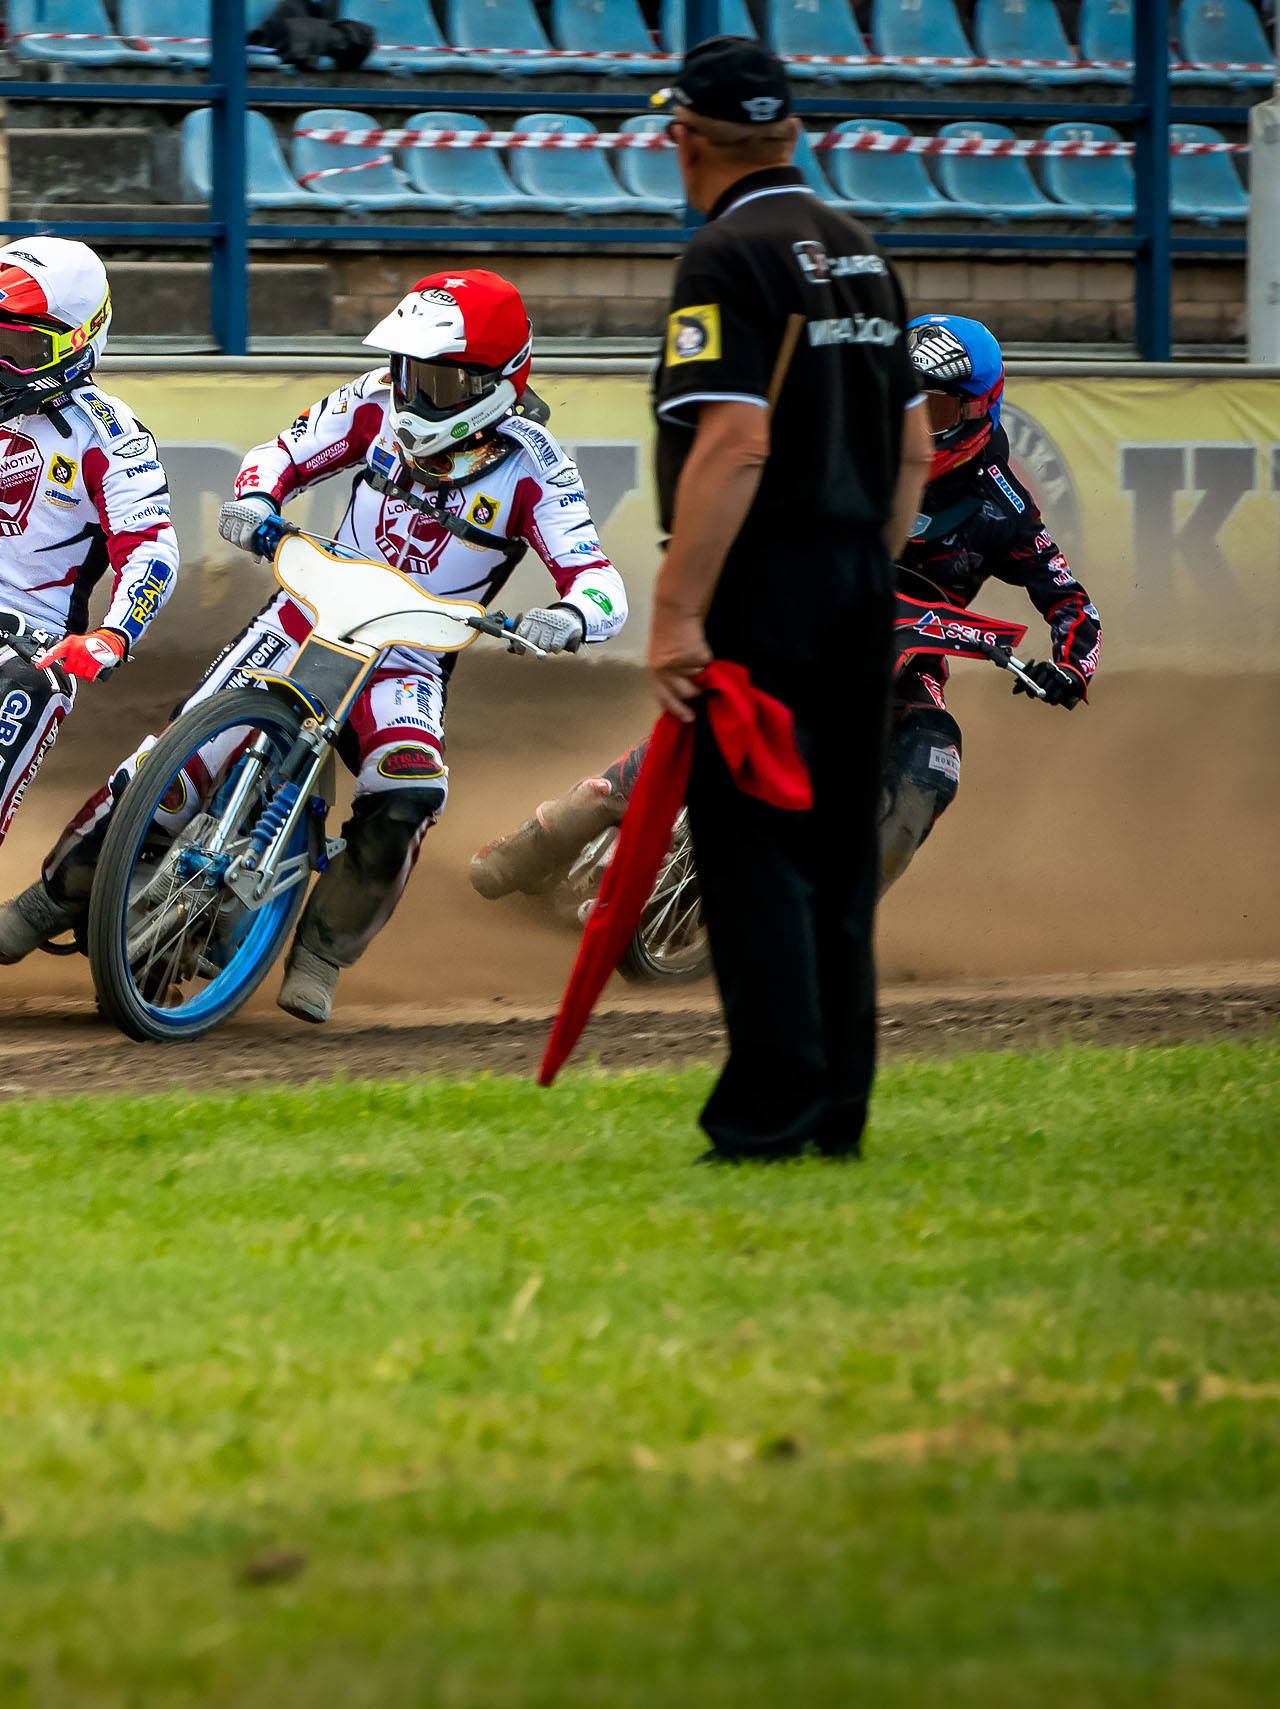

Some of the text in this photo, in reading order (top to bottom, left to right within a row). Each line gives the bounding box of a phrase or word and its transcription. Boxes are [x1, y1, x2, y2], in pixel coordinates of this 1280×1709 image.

[913, 356, 929, 365] OEI
[90, 399, 115, 428] REALL
[994, 475, 1024, 513] BERNER
[131, 574, 164, 625] REALL
